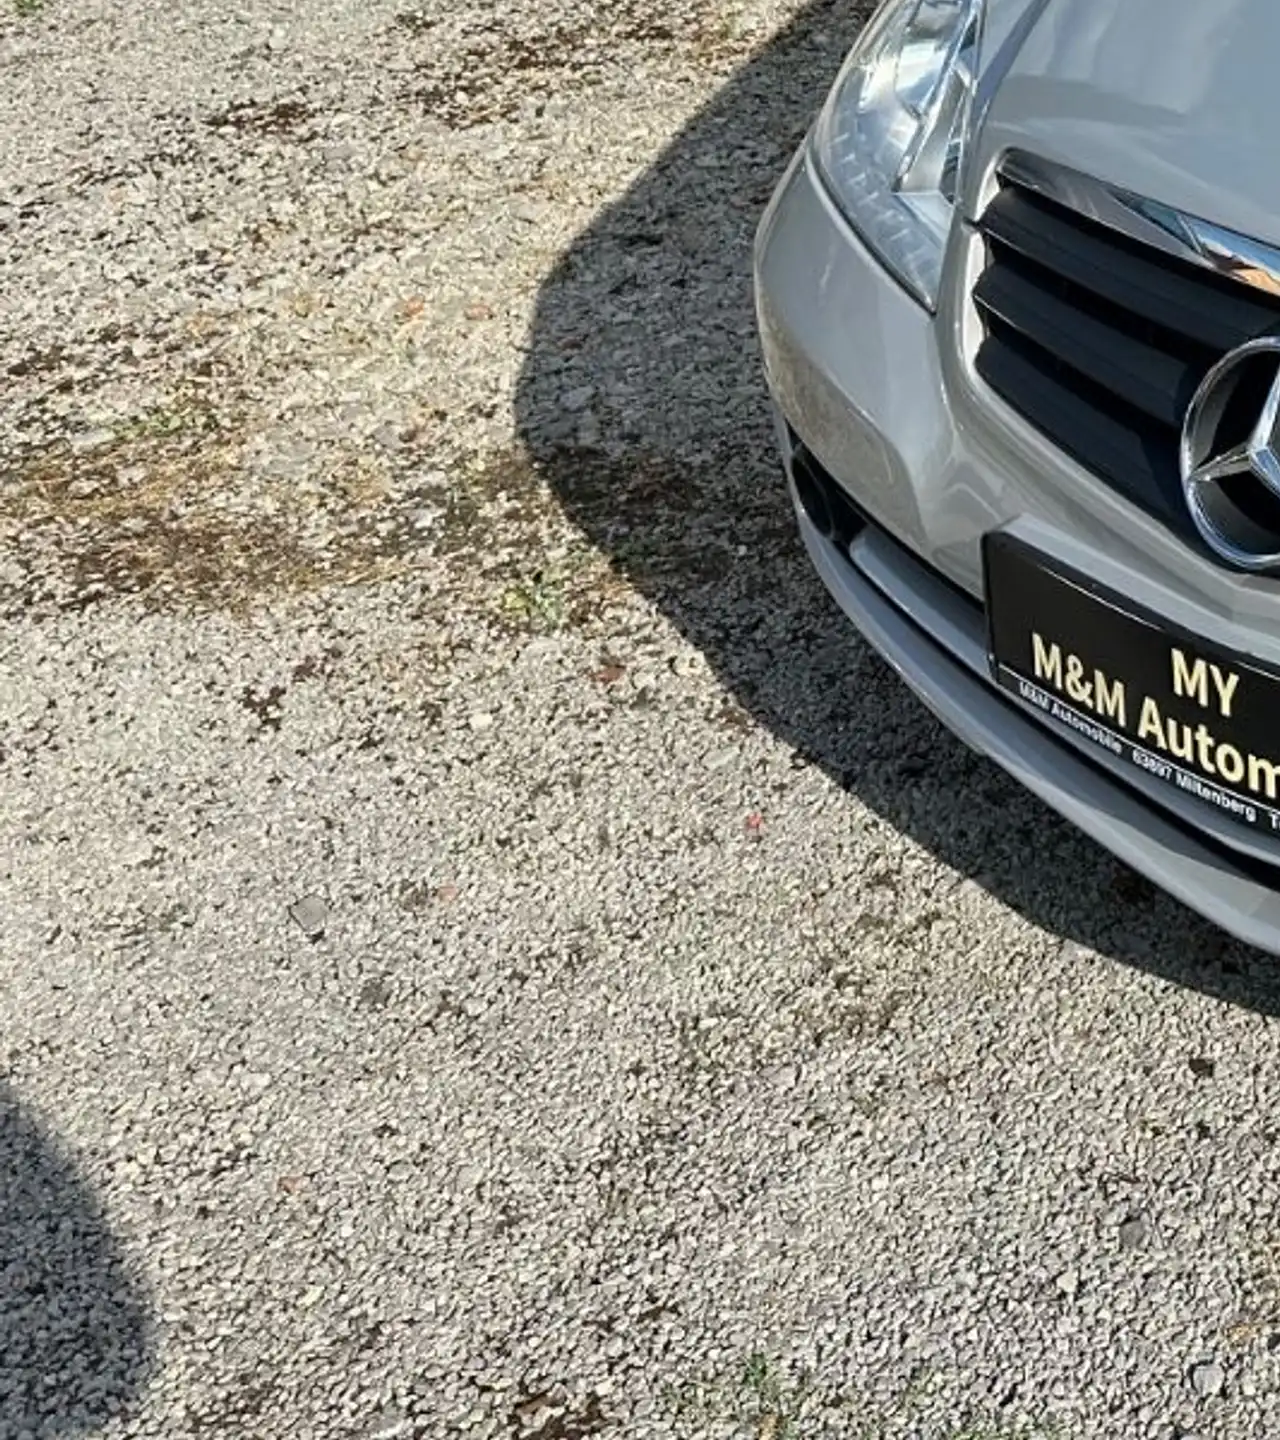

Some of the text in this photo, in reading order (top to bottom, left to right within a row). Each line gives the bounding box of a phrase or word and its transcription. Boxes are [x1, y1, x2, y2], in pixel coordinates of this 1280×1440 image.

[1032, 631, 1127, 728] M&M
[1171, 647, 1240, 717] MY
[1051, 703, 1123, 754] Automobile
[1176, 772, 1257, 823] Miltenberg
